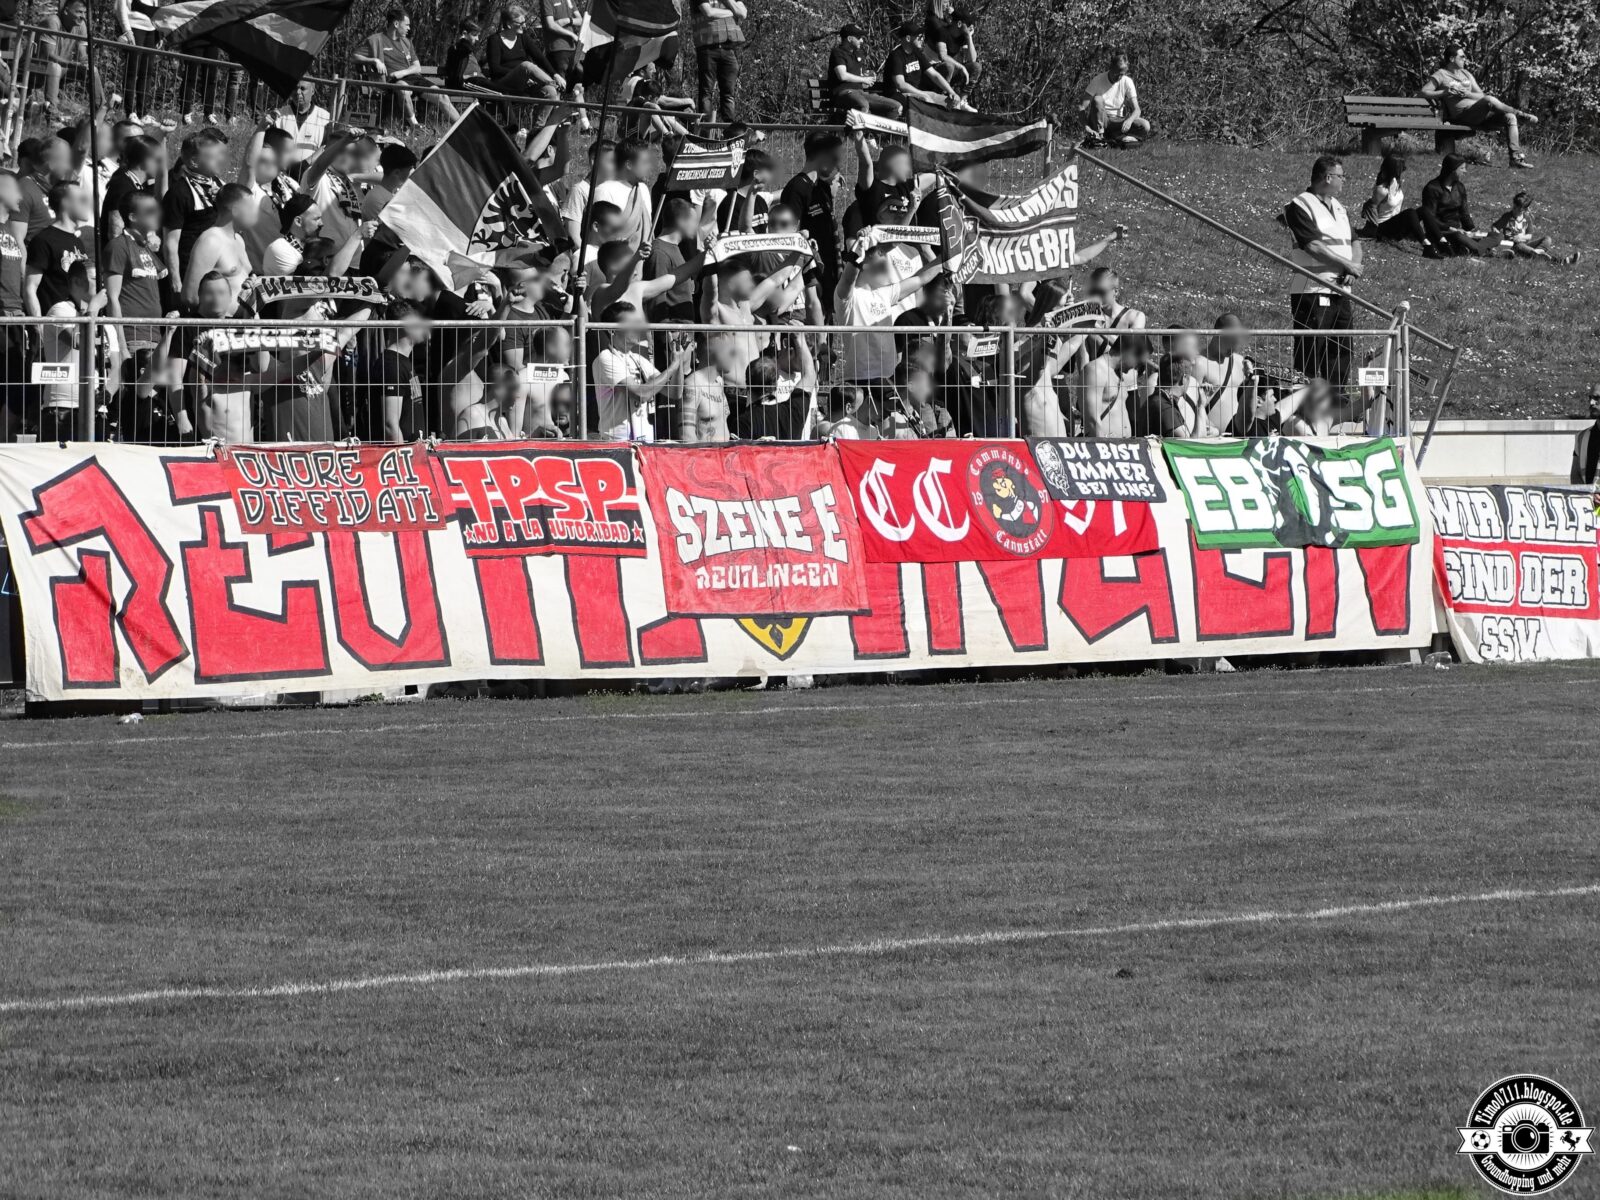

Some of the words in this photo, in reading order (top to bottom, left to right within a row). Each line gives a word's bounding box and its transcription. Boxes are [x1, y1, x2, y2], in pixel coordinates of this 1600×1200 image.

[233, 450, 363, 489] ONORE
[378, 447, 419, 486] AI
[1058, 442, 1091, 459] DU
[1096, 442, 1140, 460] BIST
[444, 456, 626, 522] TPSP
[1066, 461, 1150, 482] IMMER
[1075, 481, 1109, 496] BEI
[1113, 481, 1157, 498] UNS!
[238, 486, 439, 526] DIFFIDATI
[972, 490, 984, 506] 19
[1425, 486, 1502, 540] WIR
[1506, 490, 1597, 545] ALLE
[473, 521, 499, 543] NO
[503, 519, 517, 541] A
[520, 518, 544, 540] LA
[548, 519, 630, 543] AUTORIDAD
[665, 486, 813, 564] SZENE
[809, 484, 848, 563] E
[694, 562, 839, 590] REUTLINGEN
[1443, 550, 1514, 603] SIND
[1520, 553, 1588, 607] DER
[1479, 616, 1541, 661] SSV
